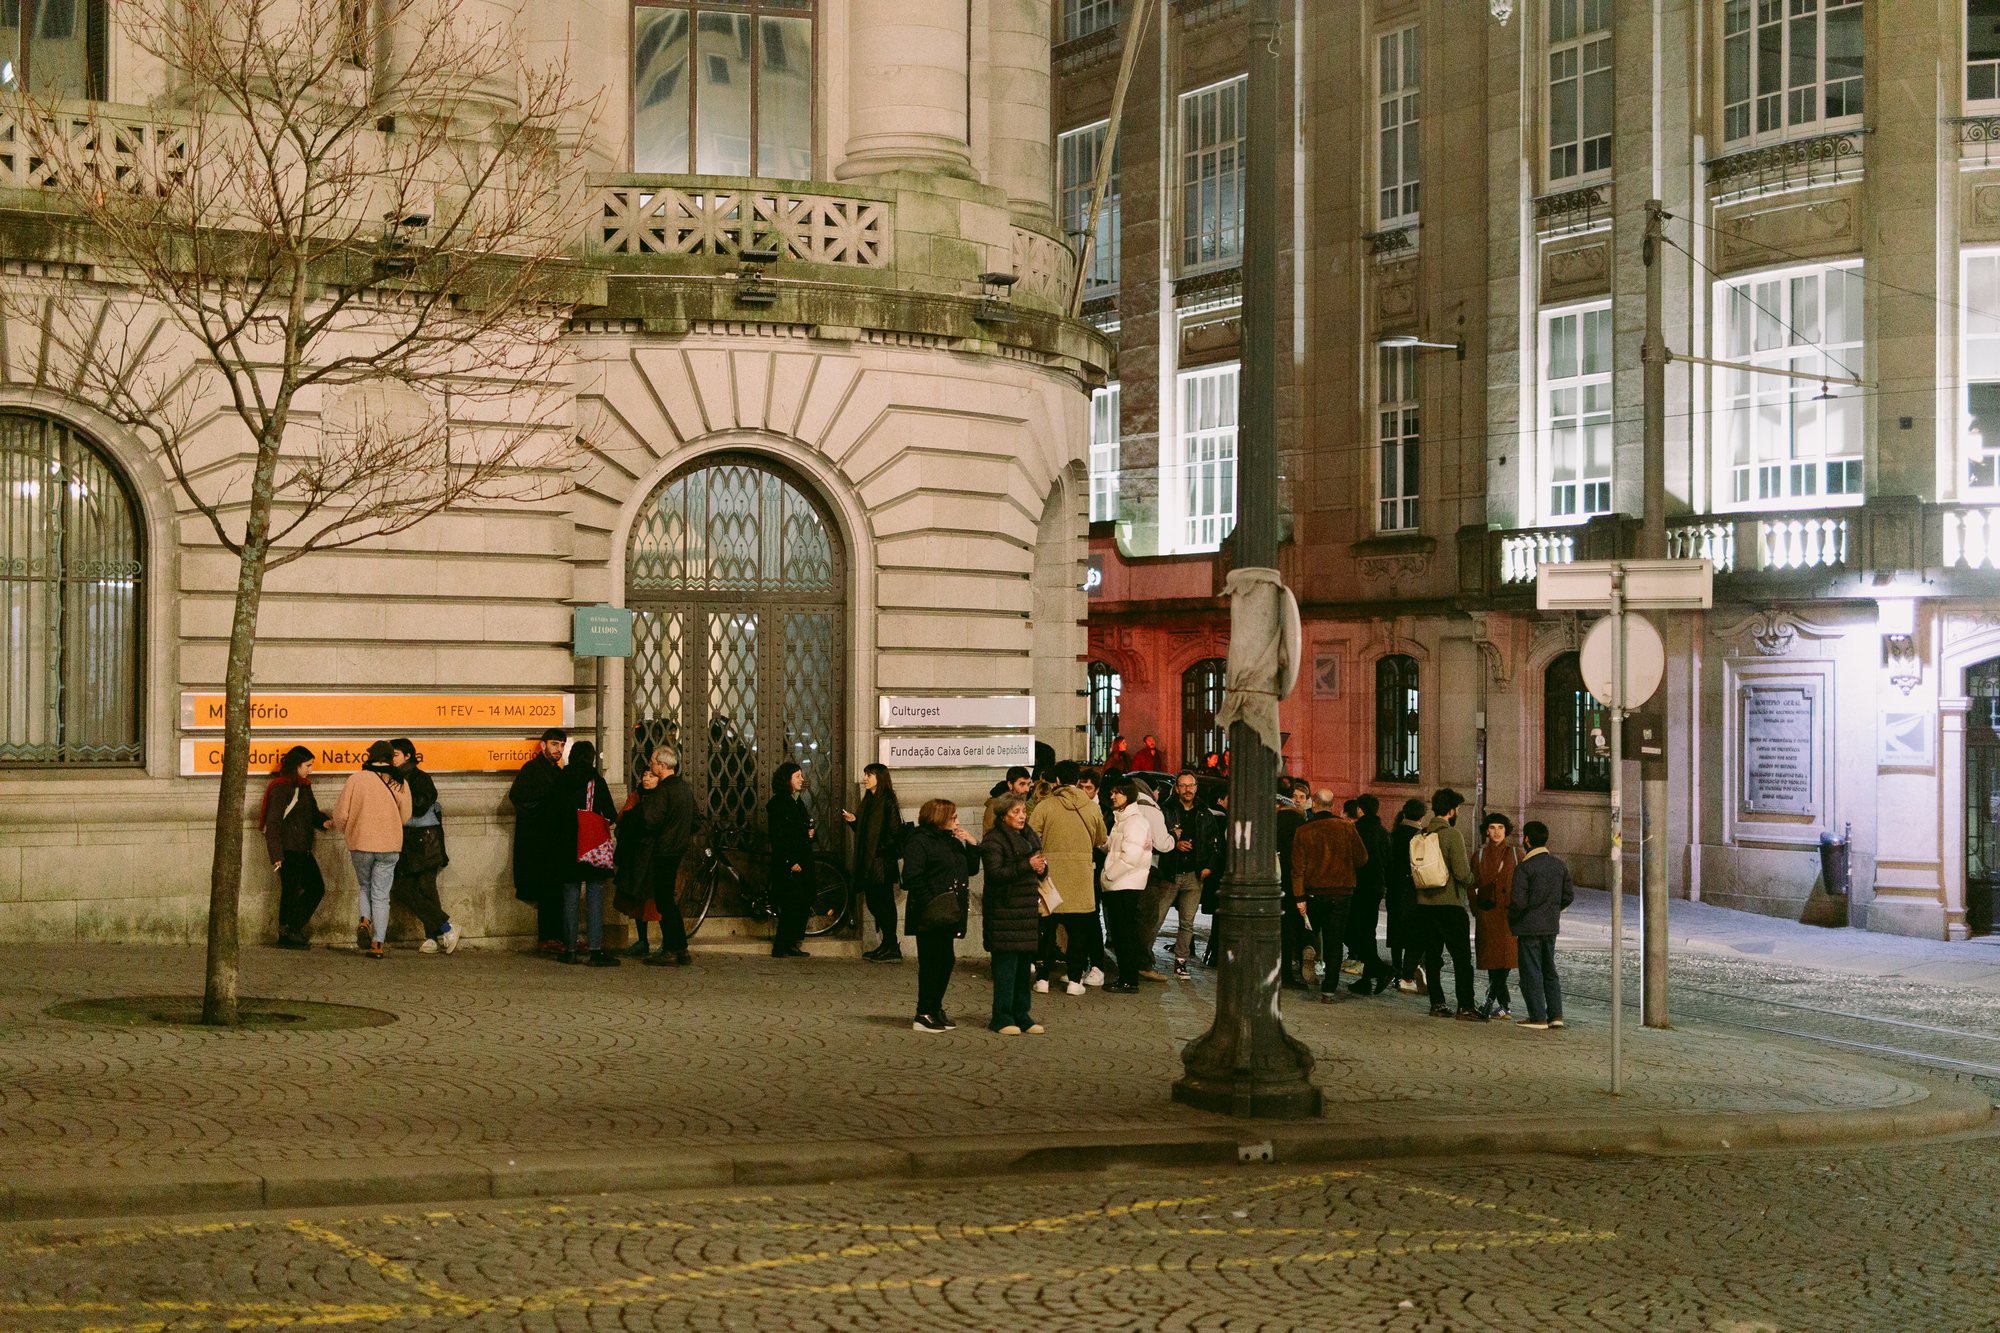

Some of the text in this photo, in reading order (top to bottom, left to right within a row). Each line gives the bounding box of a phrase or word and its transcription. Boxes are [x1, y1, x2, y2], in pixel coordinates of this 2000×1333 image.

[591, 626, 618, 634] ALIADOS
[209, 704, 288, 719] Mfório
[436, 705, 446, 716] 11
[451, 705, 473, 716] FEV
[489, 705, 501, 716] 14
[504, 705, 526, 716] MAI
[529, 705, 556, 716] 2023
[891, 706, 940, 718] Culturgest
[890, 745, 1029, 758] Fundação Caixa Geral de Depósitos
